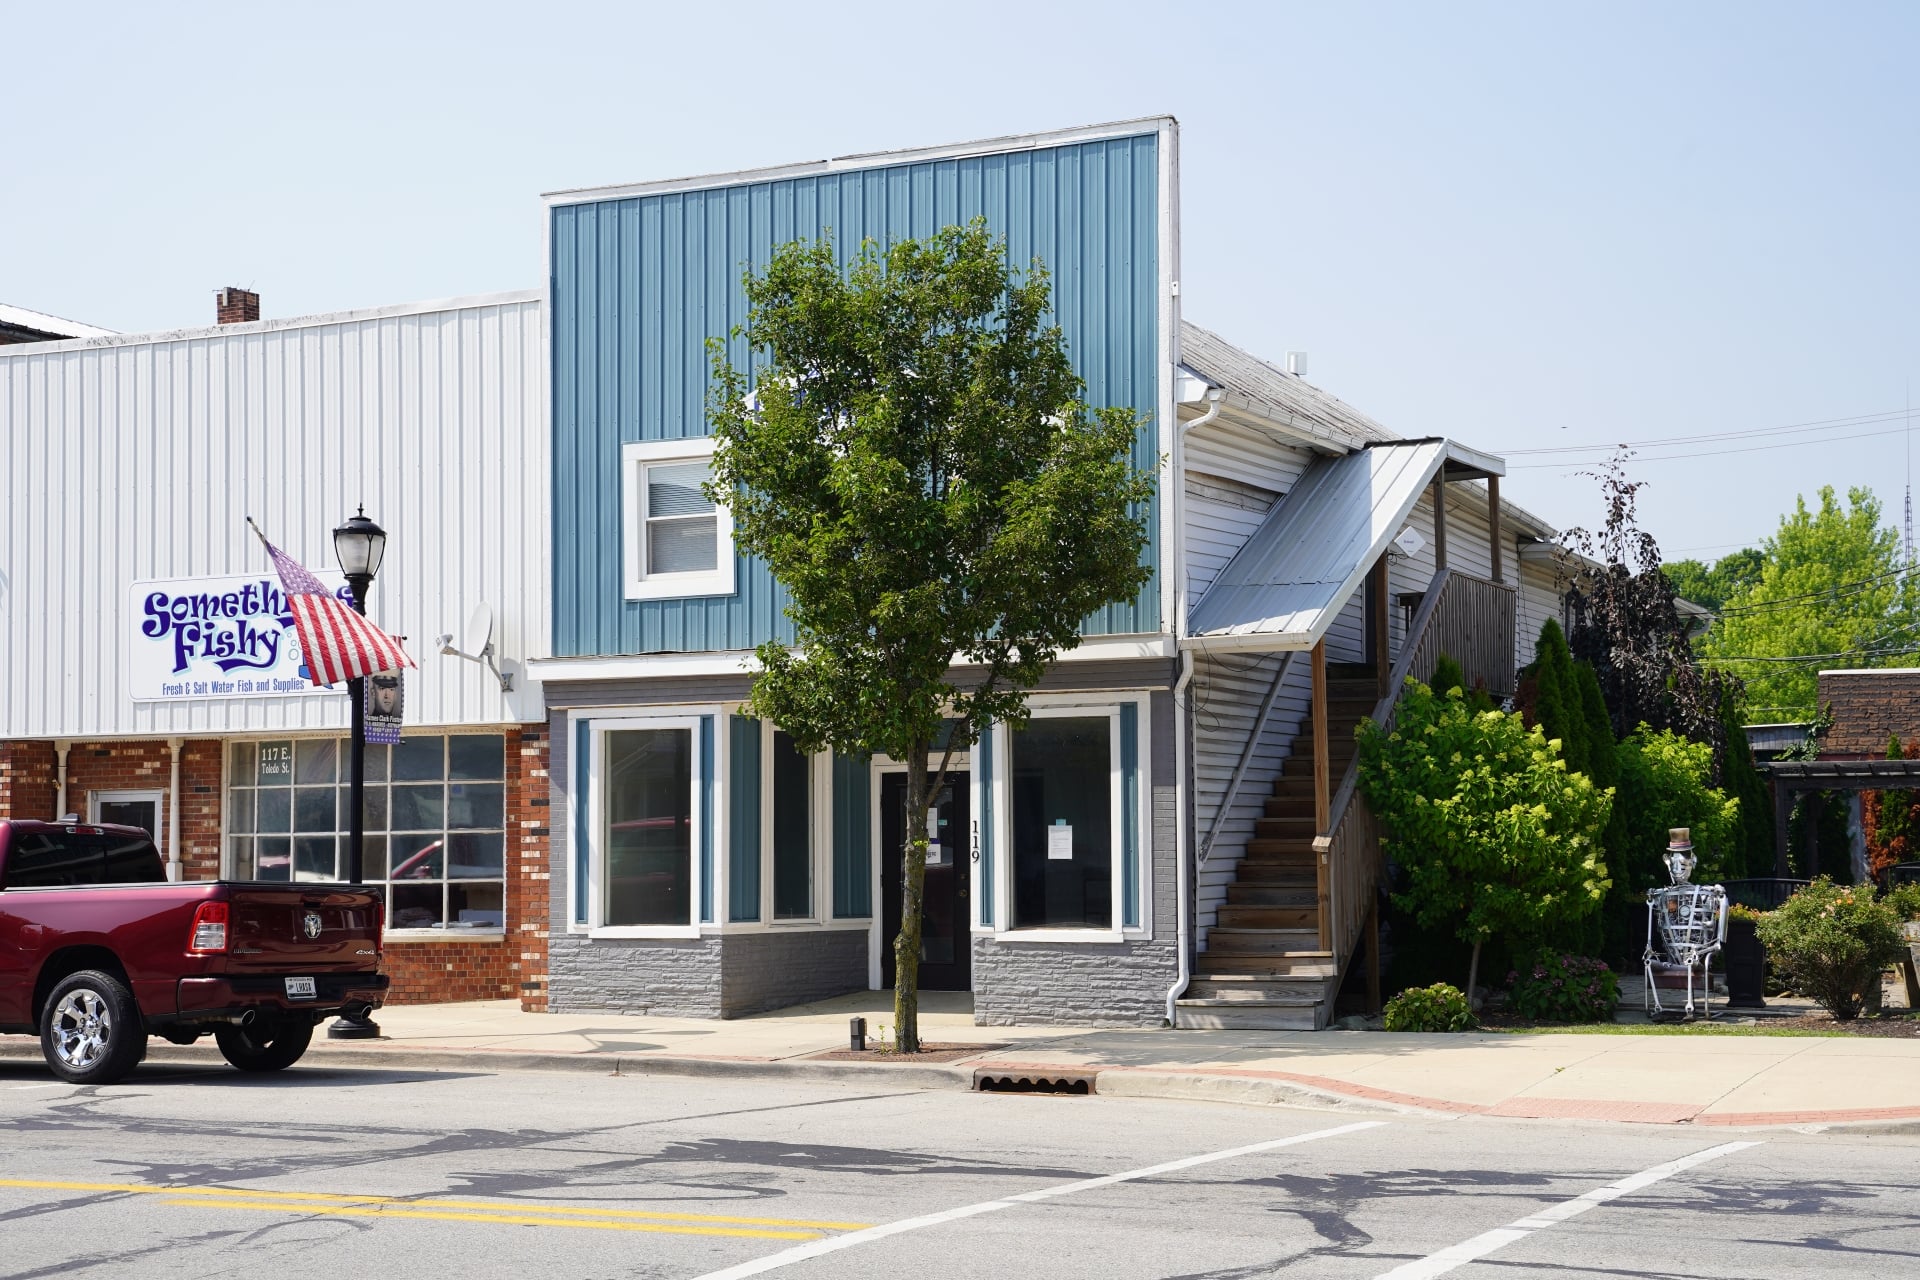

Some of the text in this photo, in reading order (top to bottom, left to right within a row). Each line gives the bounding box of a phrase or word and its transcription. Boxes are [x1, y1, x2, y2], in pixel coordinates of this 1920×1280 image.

[171, 620, 280, 673] Fishy
[162, 677, 305, 696] Fresh & Salt Water Fish and Supplies
[261, 746, 291, 761] 117 E.
[261, 762, 280, 774] Toledo
[971, 820, 980, 863] 119
